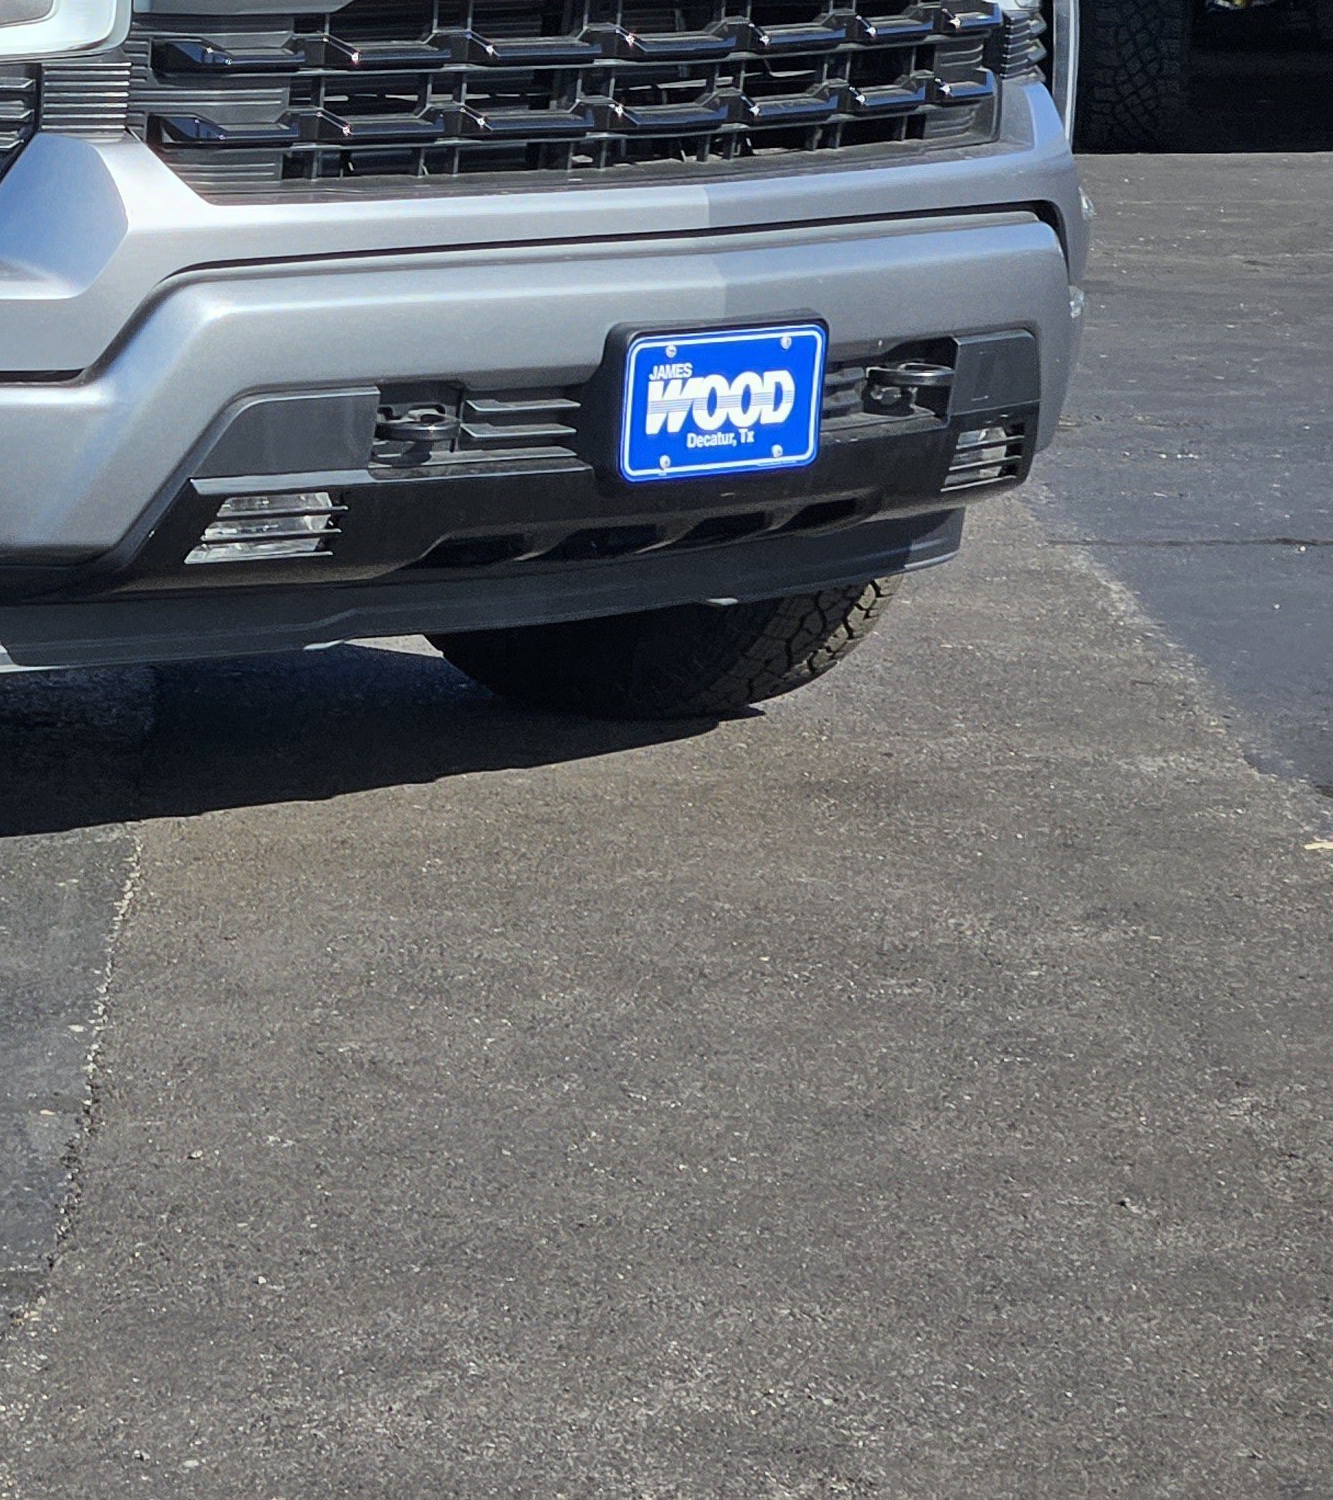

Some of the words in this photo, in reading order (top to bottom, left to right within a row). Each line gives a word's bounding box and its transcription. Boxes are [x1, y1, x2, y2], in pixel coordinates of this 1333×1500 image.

[648, 362, 693, 381] JAMES
[645, 369, 796, 435] WOOD
[686, 431, 737, 449] Decatur,
[739, 428, 755, 445] Tx
